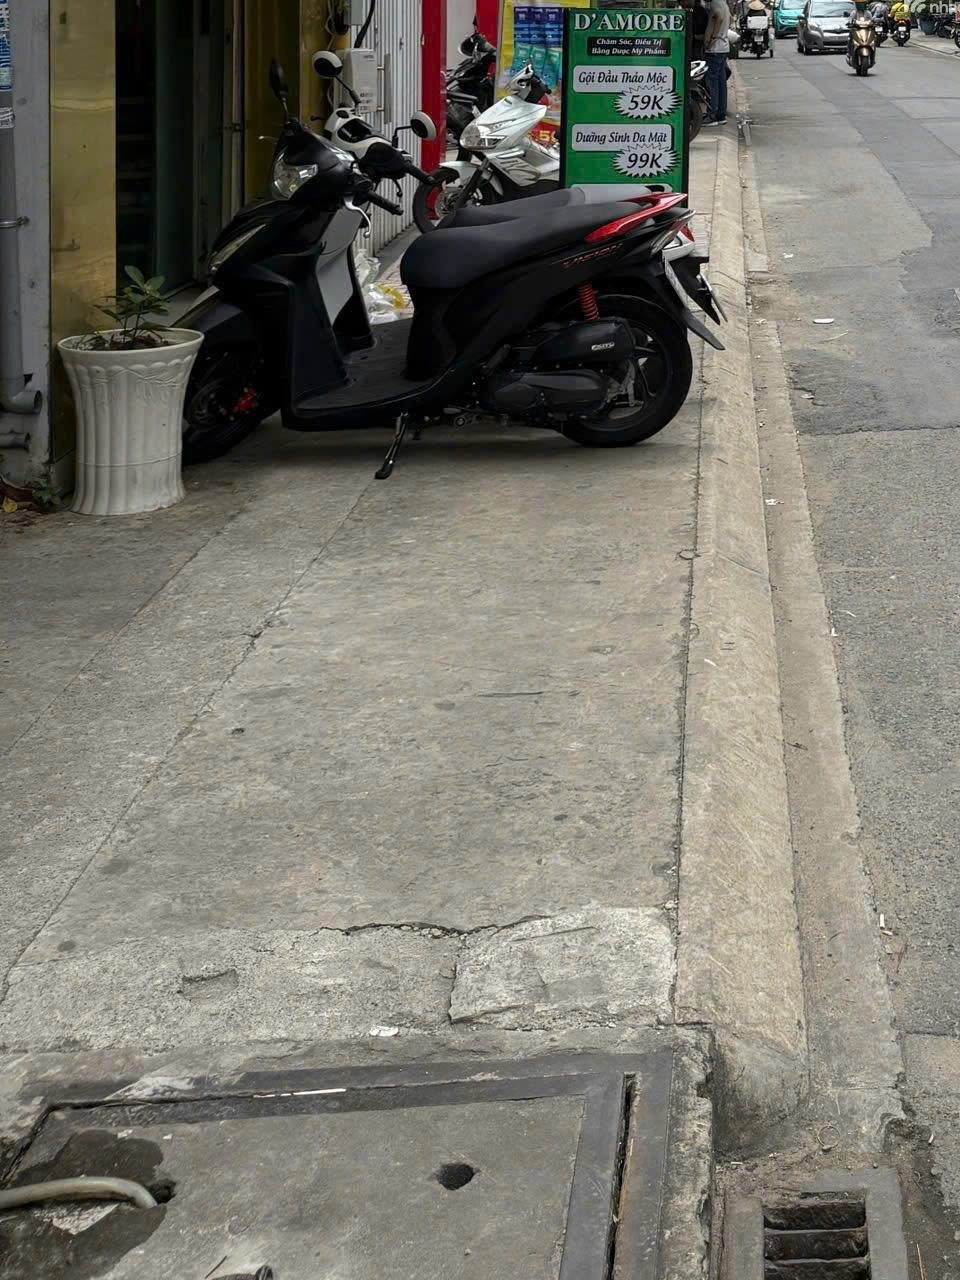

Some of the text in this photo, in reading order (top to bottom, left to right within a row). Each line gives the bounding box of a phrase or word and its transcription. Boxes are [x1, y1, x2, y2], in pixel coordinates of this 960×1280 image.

[578, 71, 595, 86] Gội
[597, 69, 618, 84] Đầu
[646, 72, 668, 86] Mộc
[627, 94, 664, 111] 59K
[608, 131, 630, 143] Sinh
[632, 131, 646, 143] Da
[626, 153, 663, 169] 99K
